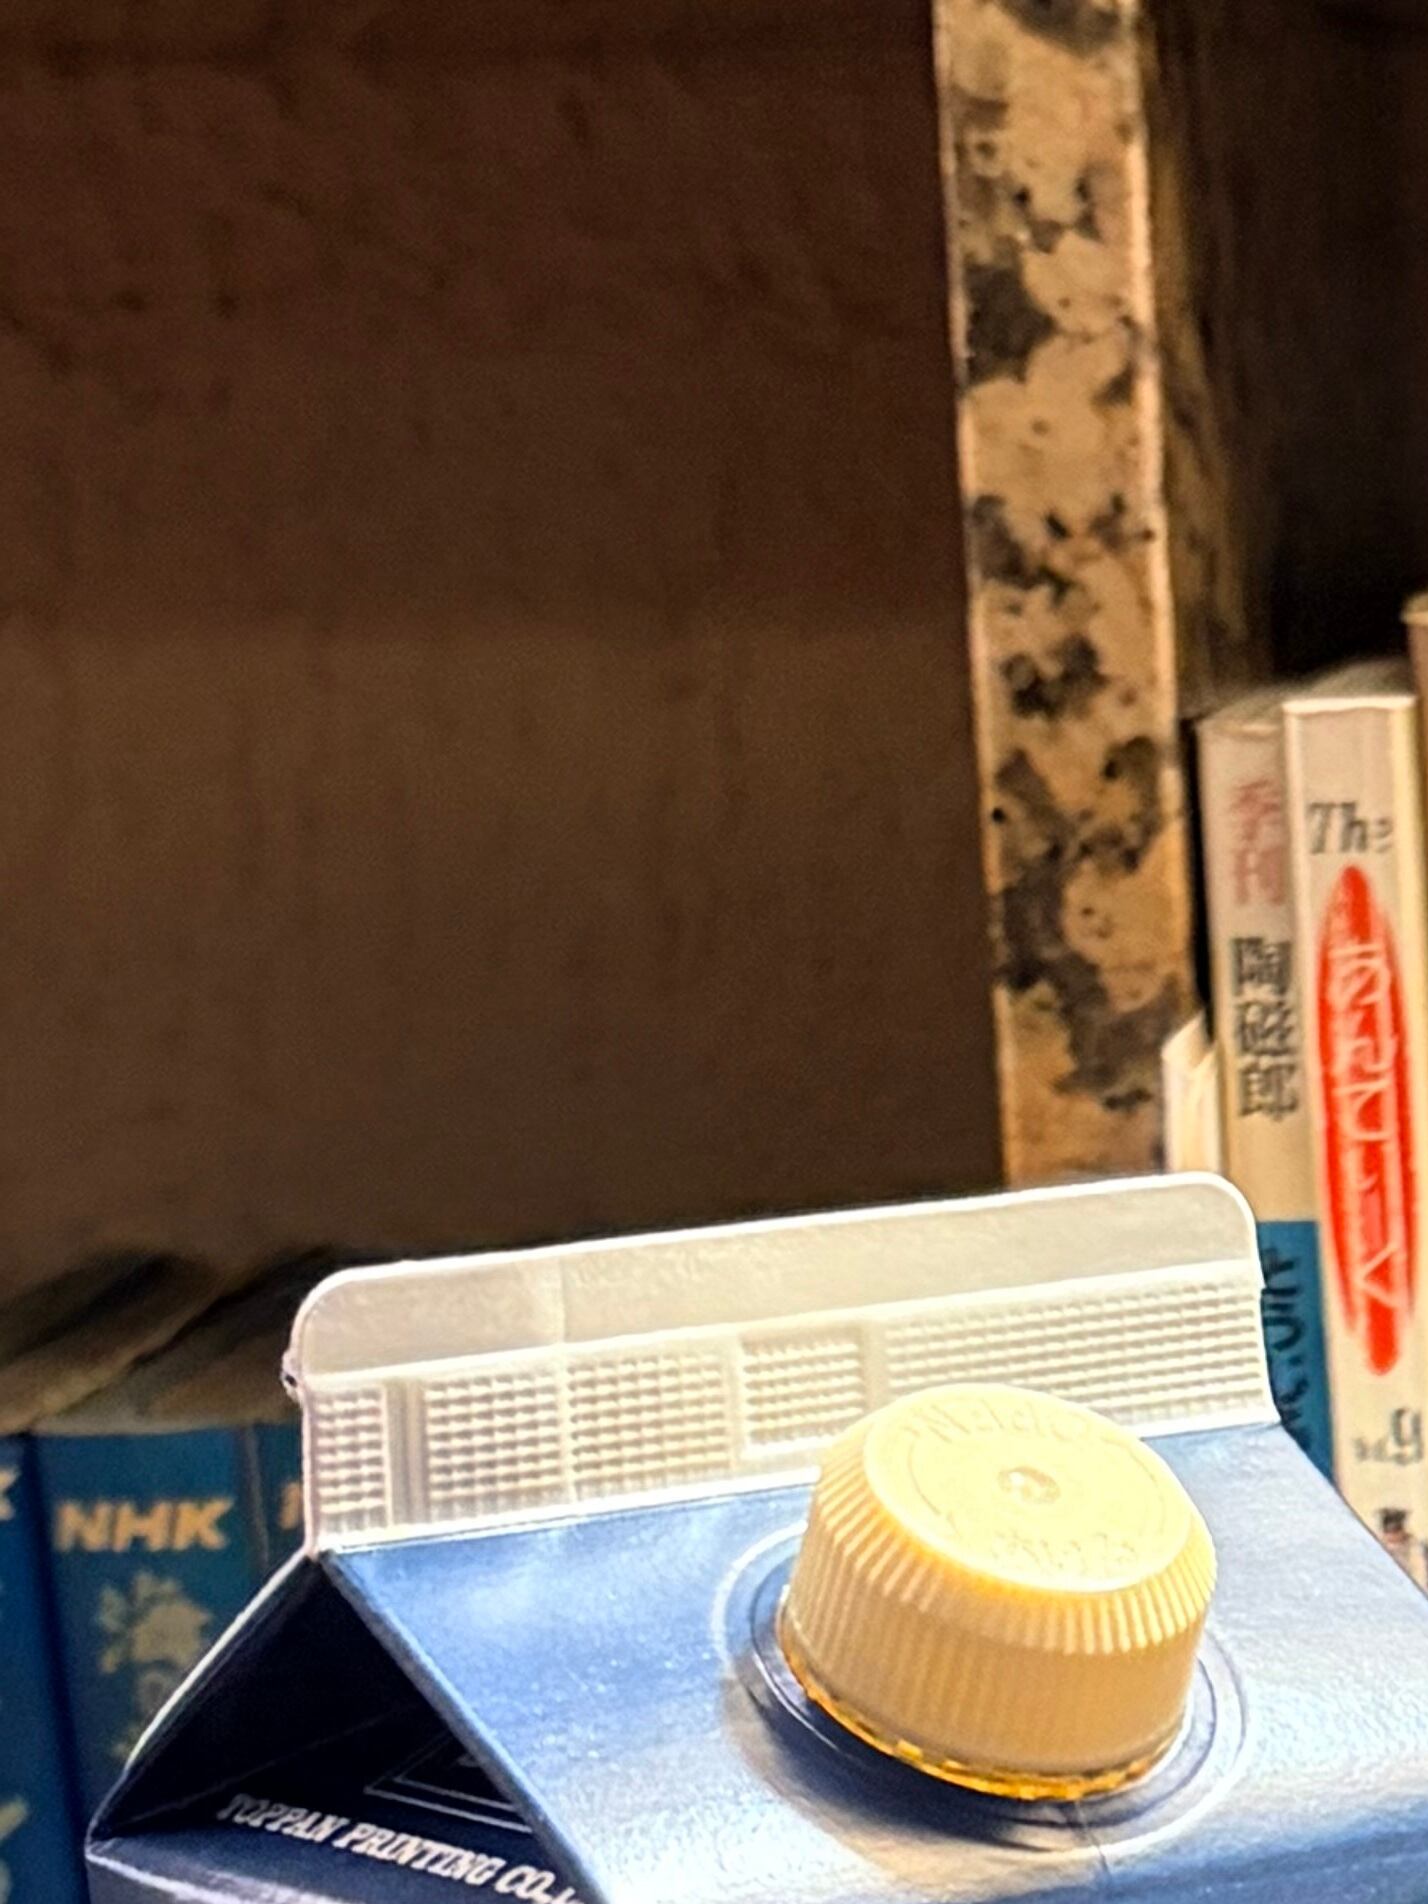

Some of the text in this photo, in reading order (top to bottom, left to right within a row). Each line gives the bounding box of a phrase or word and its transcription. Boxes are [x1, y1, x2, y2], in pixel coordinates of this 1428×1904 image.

[1308, 801, 1393, 857] The
[53, 1497, 234, 1553] NHK
[215, 1792, 350, 1844] TOPPAN
[331, 1821, 506, 1887] PRINTING
